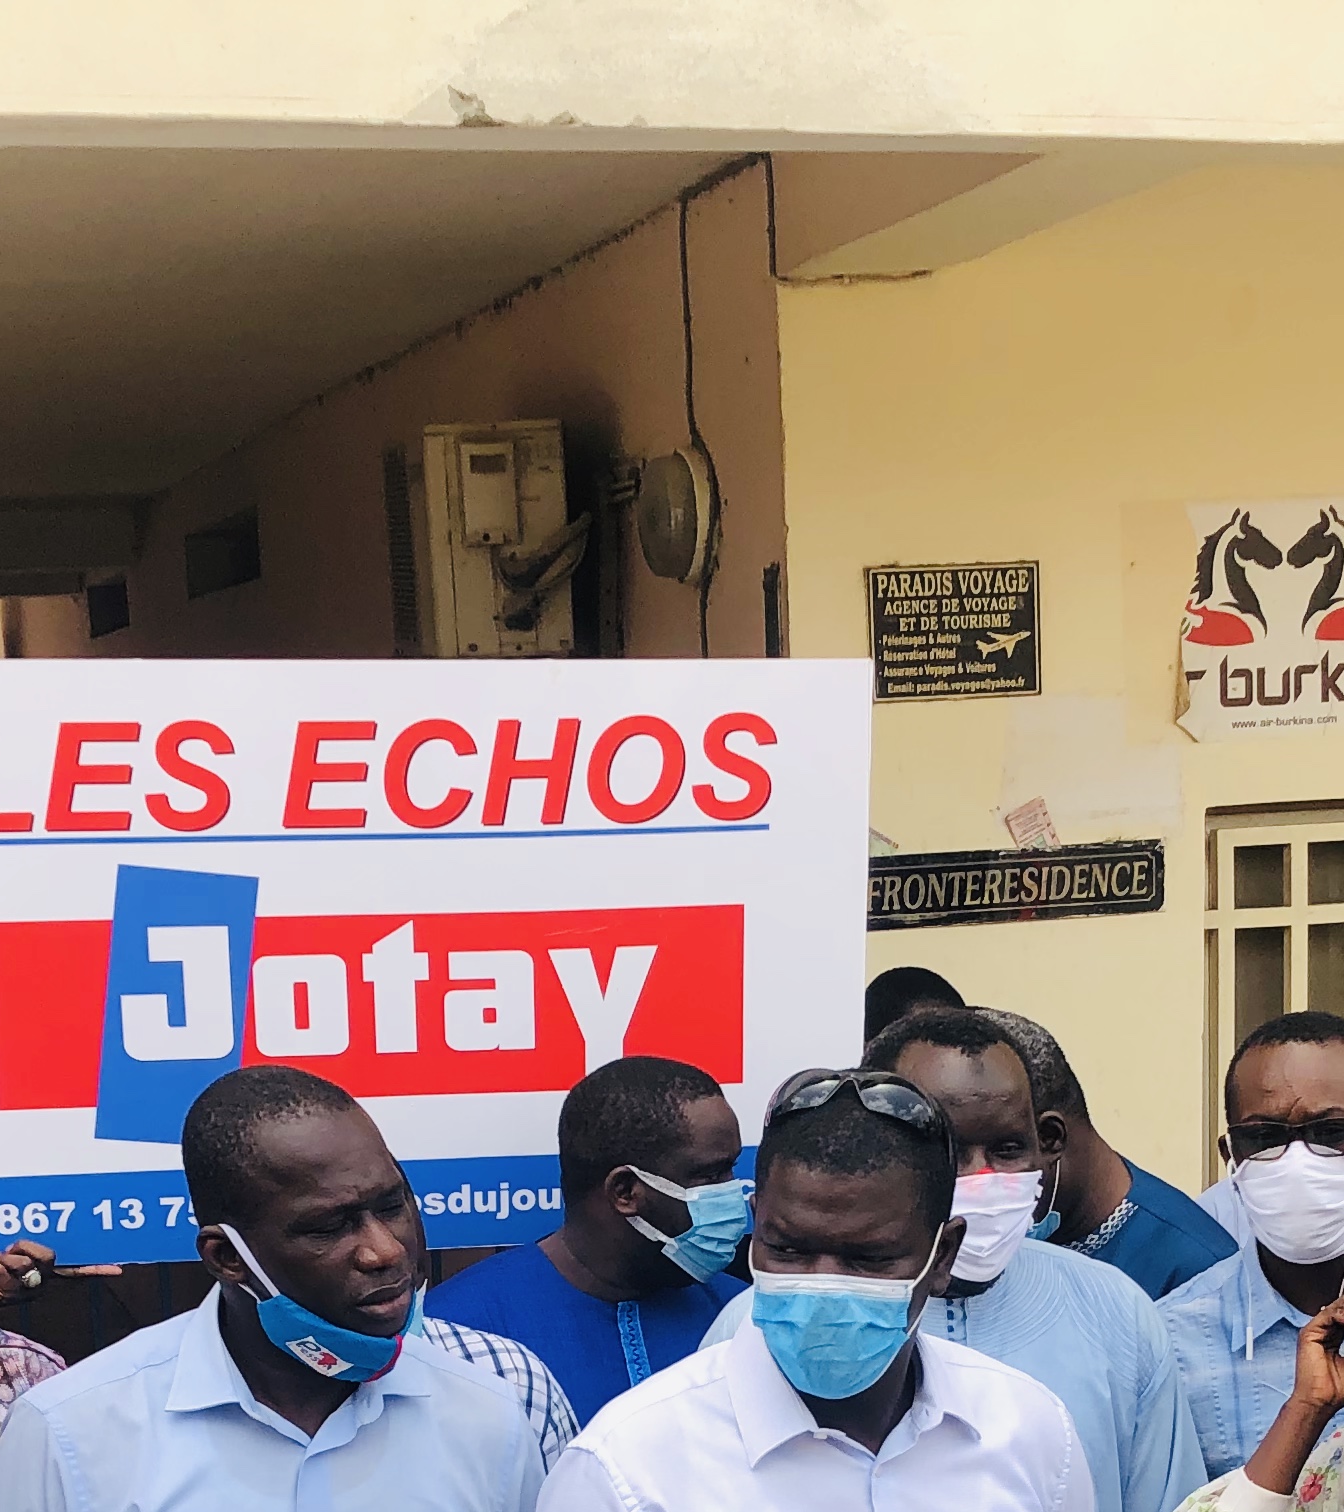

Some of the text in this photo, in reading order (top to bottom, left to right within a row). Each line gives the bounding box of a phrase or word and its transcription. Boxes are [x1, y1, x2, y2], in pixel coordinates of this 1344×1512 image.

[877, 570, 1030, 598] PARADIS VOYAGE
[884, 599, 938, 616] AGENCE
[942, 598, 960, 613] DE
[899, 613, 1011, 632] ET DE TOURISME
[283, 711, 778, 830] ECHOS
[120, 920, 657, 1076] Jotay
[92, 1198, 146, 1230] 13
